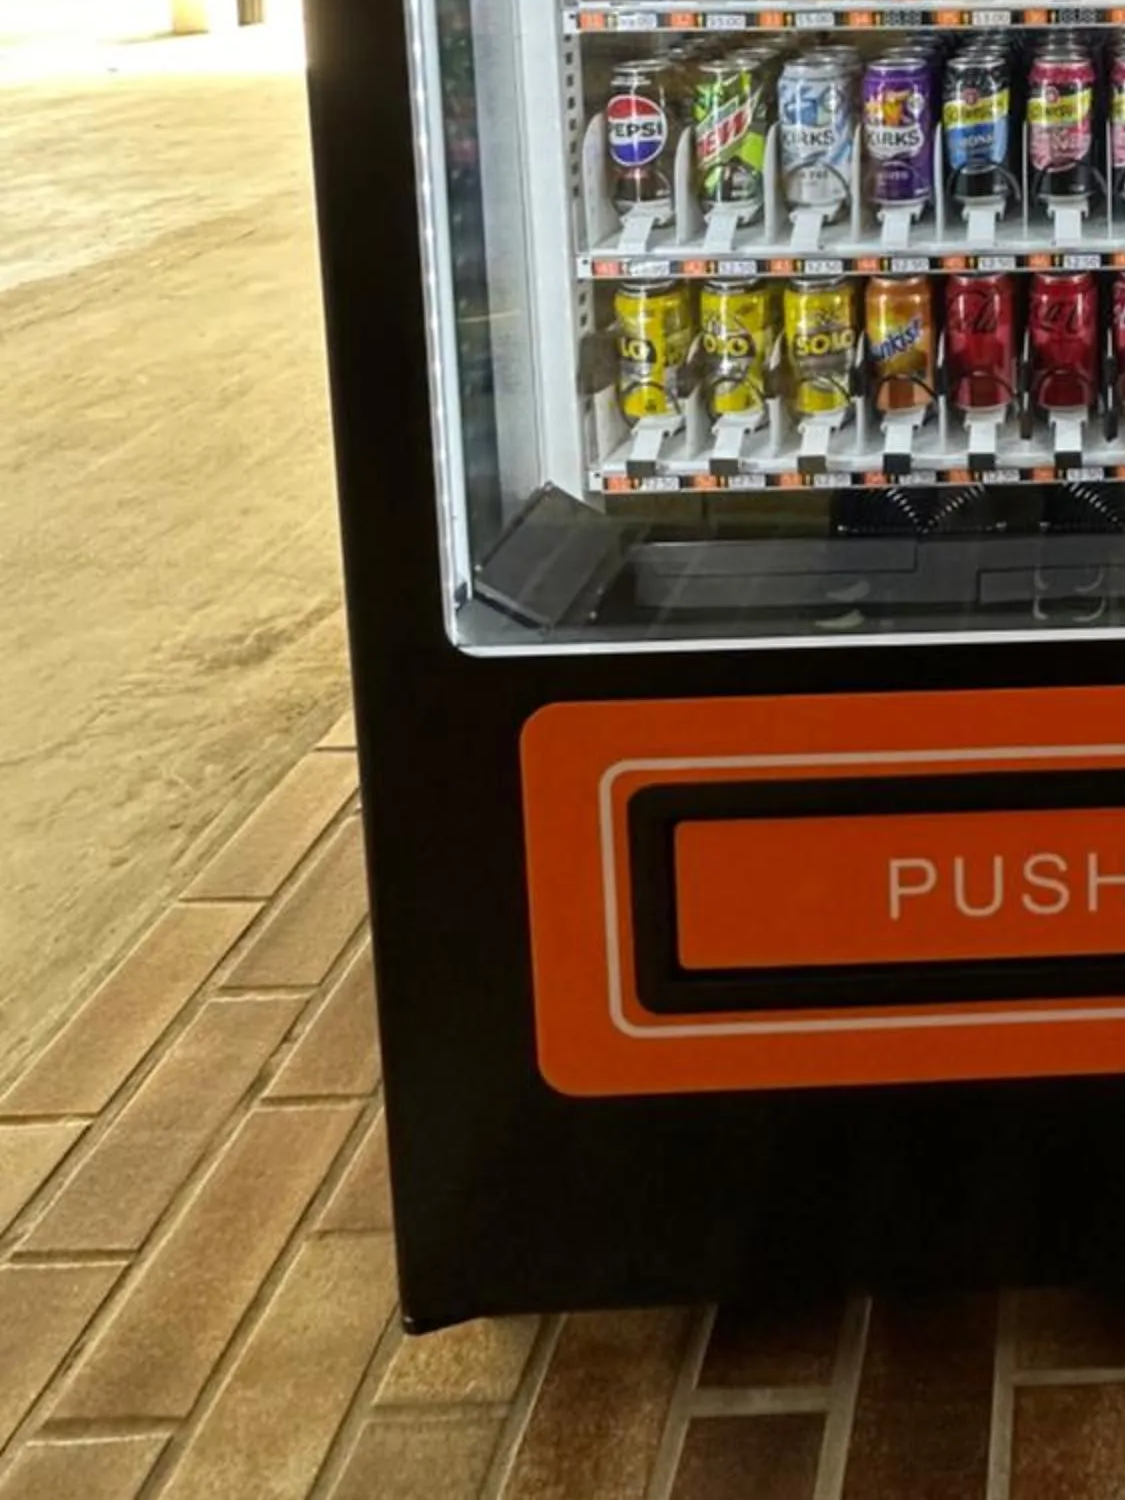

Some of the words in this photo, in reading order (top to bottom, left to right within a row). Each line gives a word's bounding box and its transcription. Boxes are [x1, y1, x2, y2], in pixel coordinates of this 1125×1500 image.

[784, 129, 836, 147] KIRKS
[867, 129, 920, 147] KIRKS
[795, 329, 857, 357] SOLO
